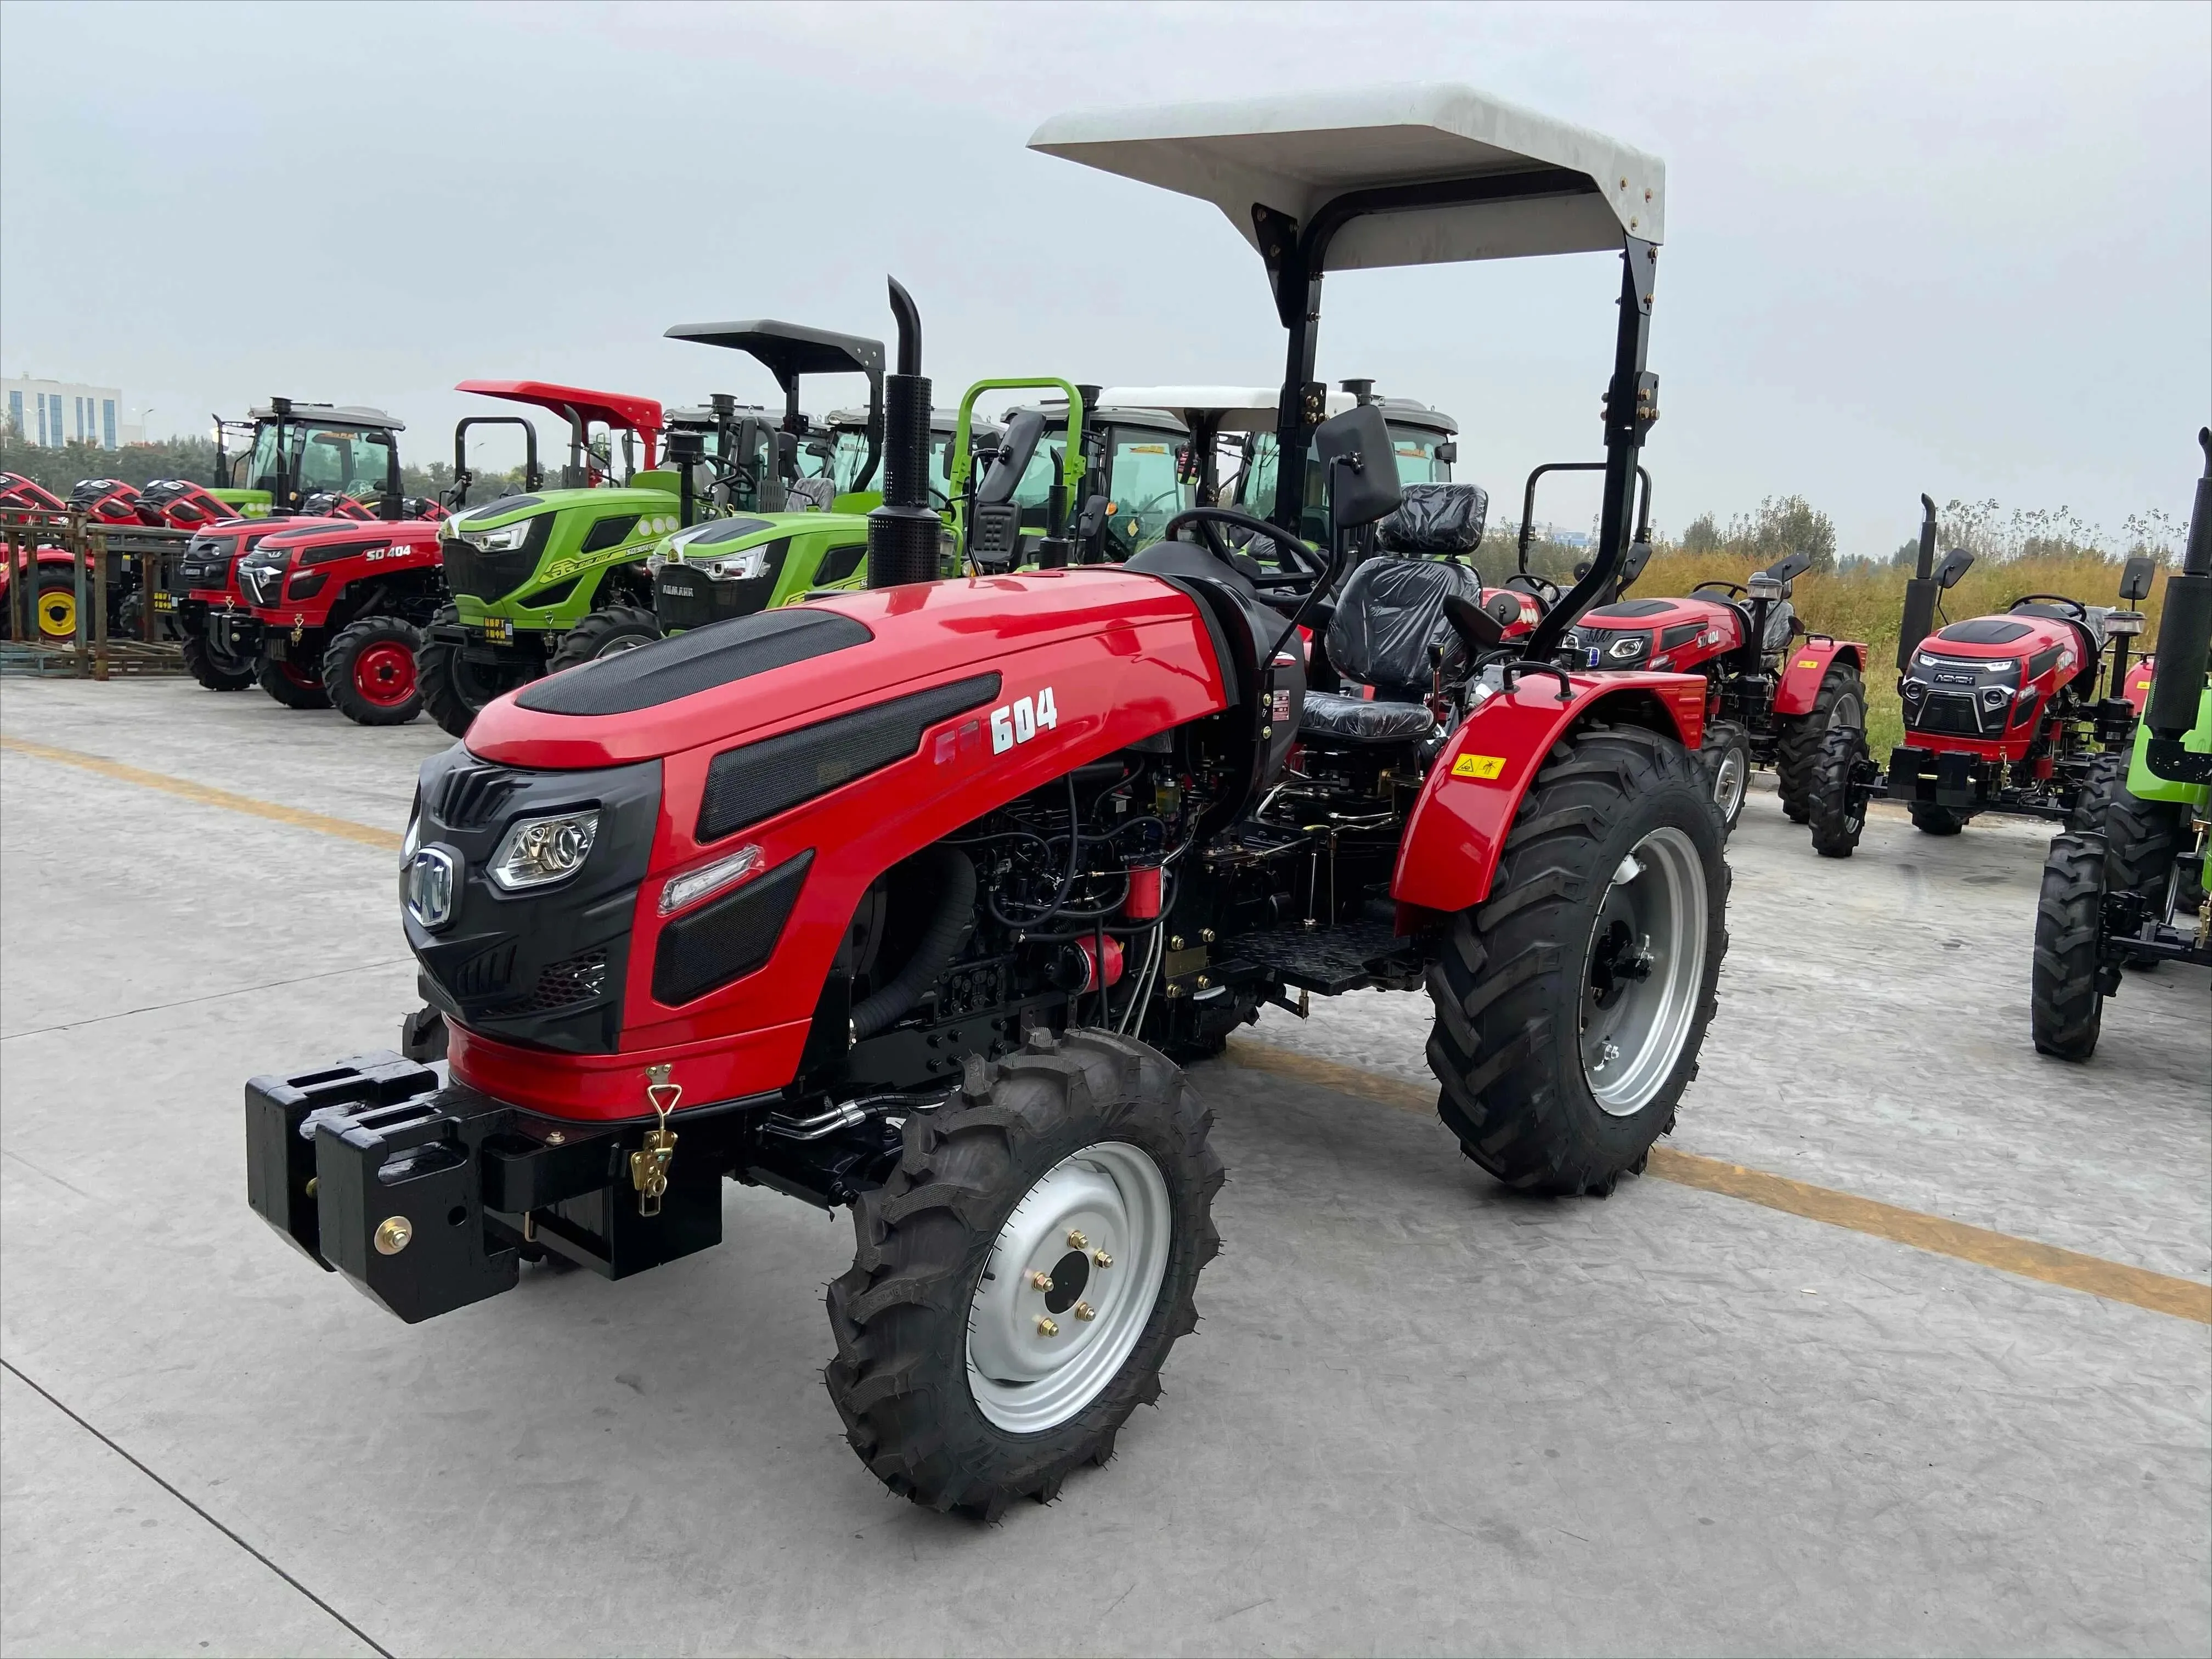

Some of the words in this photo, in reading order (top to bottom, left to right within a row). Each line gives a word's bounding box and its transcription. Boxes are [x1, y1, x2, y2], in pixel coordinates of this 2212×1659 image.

[366, 549, 385, 561] SD
[387, 545, 411, 558] 404
[1707, 630, 1719, 644] 404
[990, 686, 1058, 755] 604
